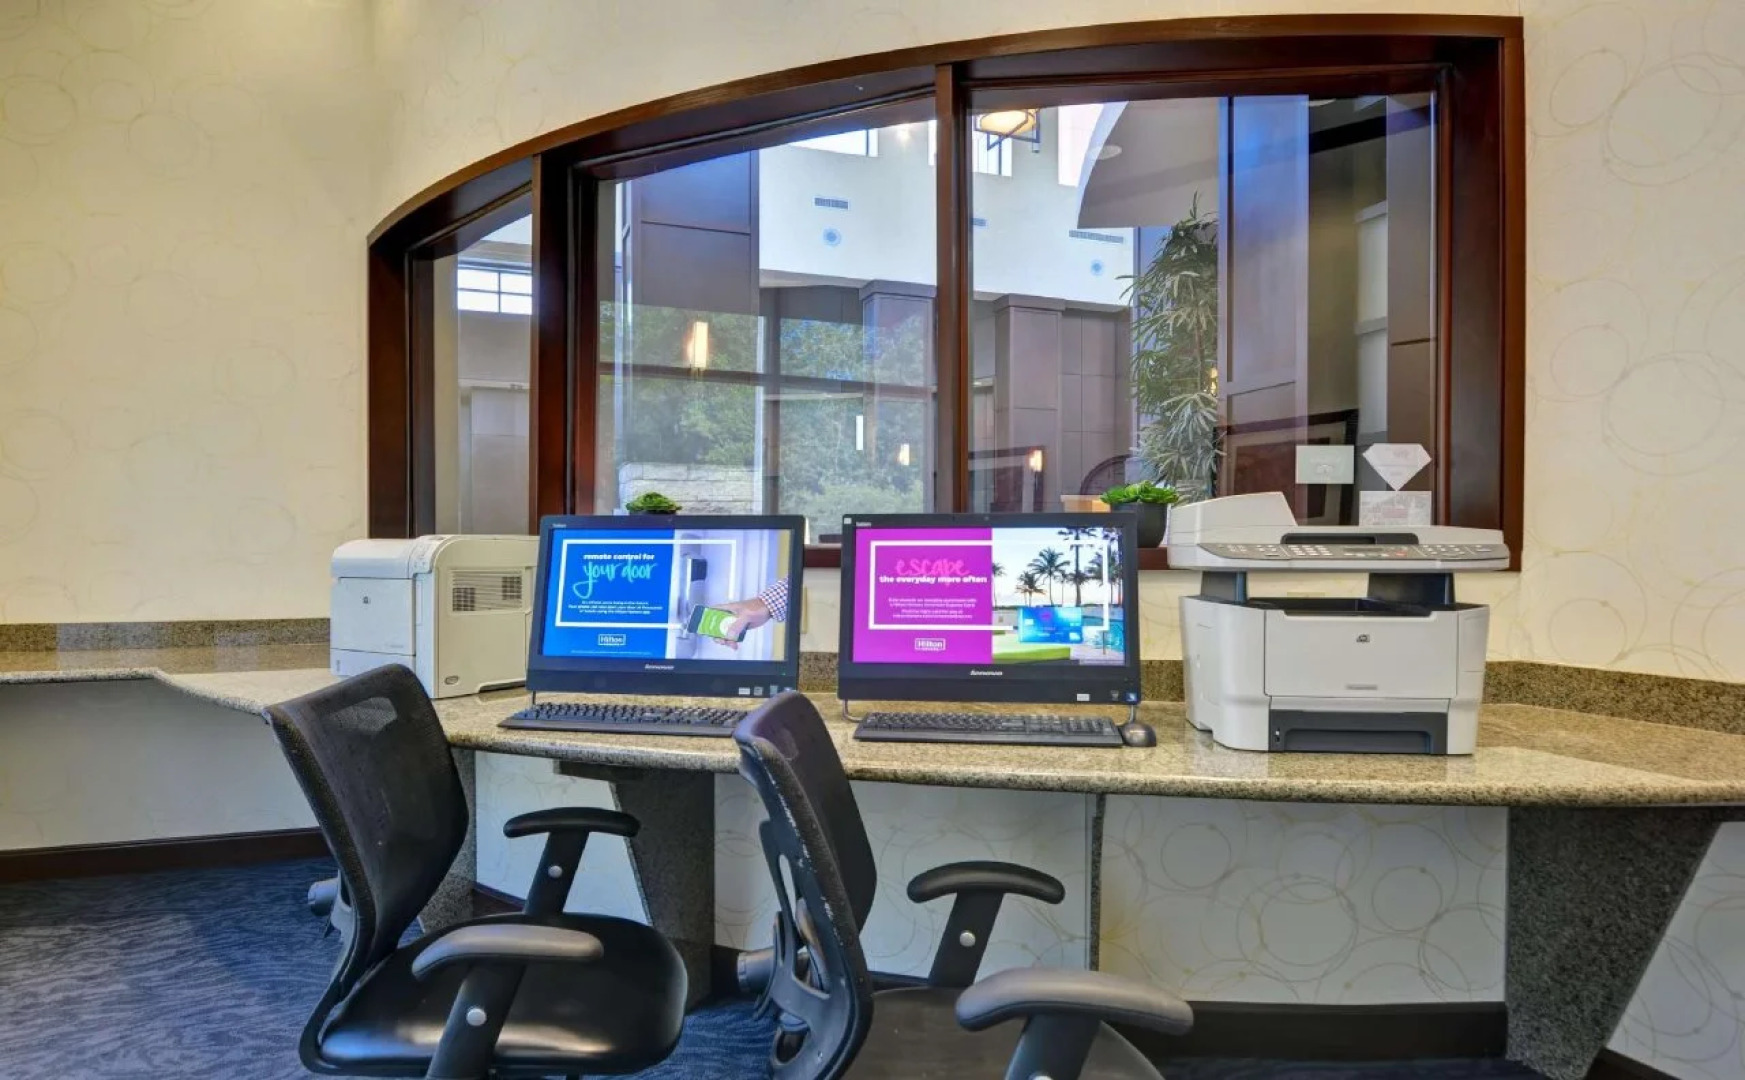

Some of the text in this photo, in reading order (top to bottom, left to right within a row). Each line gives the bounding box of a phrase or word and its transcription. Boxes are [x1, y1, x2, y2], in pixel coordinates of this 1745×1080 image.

[643, 552, 655, 560] for
[896, 559, 970, 583] escape
[572, 560, 658, 599] your door
[879, 575, 894, 583] the
[896, 574, 935, 584] everyday
[962, 574, 988, 583] often
[918, 639, 943, 648] Hilton
